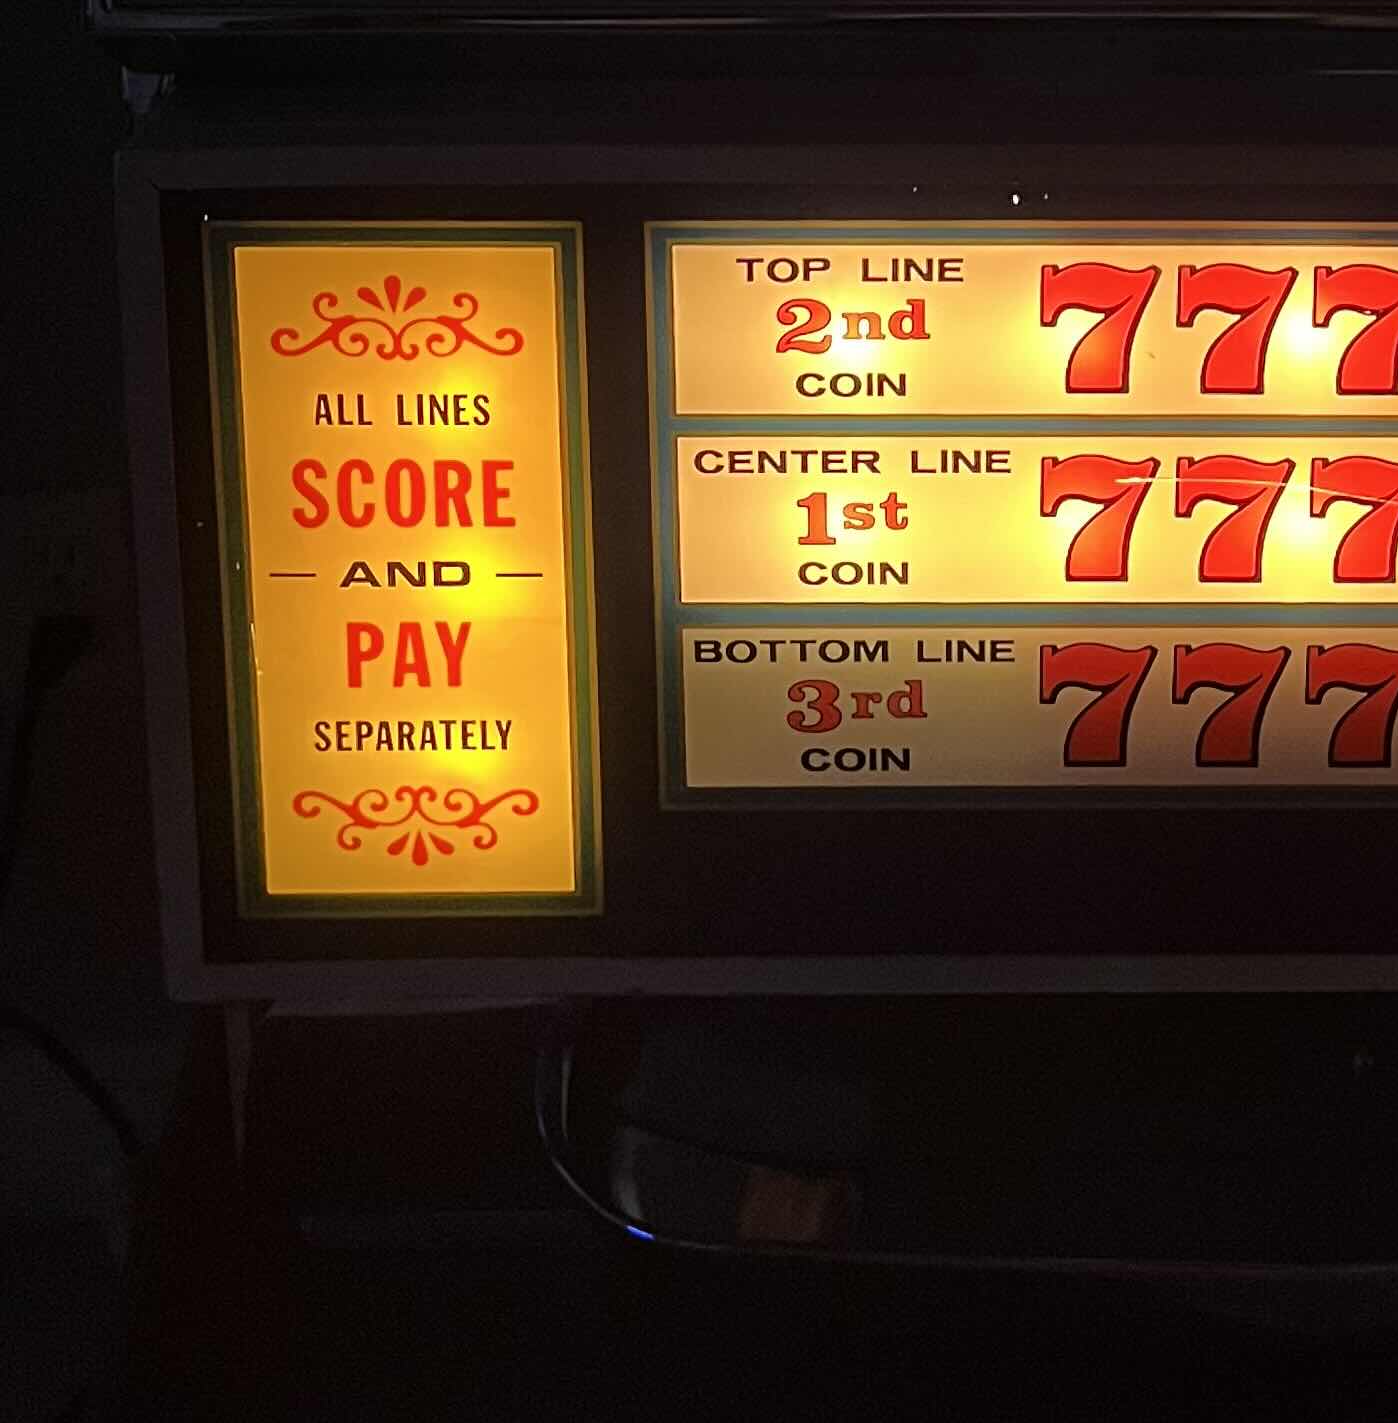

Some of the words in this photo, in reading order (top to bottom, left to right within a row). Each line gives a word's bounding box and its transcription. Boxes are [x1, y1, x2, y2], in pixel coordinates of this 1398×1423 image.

[736, 257, 832, 283] TOP
[861, 258, 965, 283] LINE
[775, 298, 931, 354] 2nd
[795, 372, 908, 398] COIN
[314, 393, 373, 426] ALL
[396, 393, 491, 427] LINES
[693, 449, 881, 475] CENTER
[910, 449, 1012, 475] LINE
[291, 458, 517, 530] SCORE
[796, 492, 909, 546] 1st
[339, 561, 471, 588] AND
[797, 561, 910, 586] COIN
[345, 621, 472, 689] PAY
[693, 639, 890, 664] BOTTOM
[916, 639, 1016, 664] LINE
[785, 679, 928, 734] 3rd
[313, 719, 513, 752] SEPARATELY
[800, 747, 912, 773] COIN
